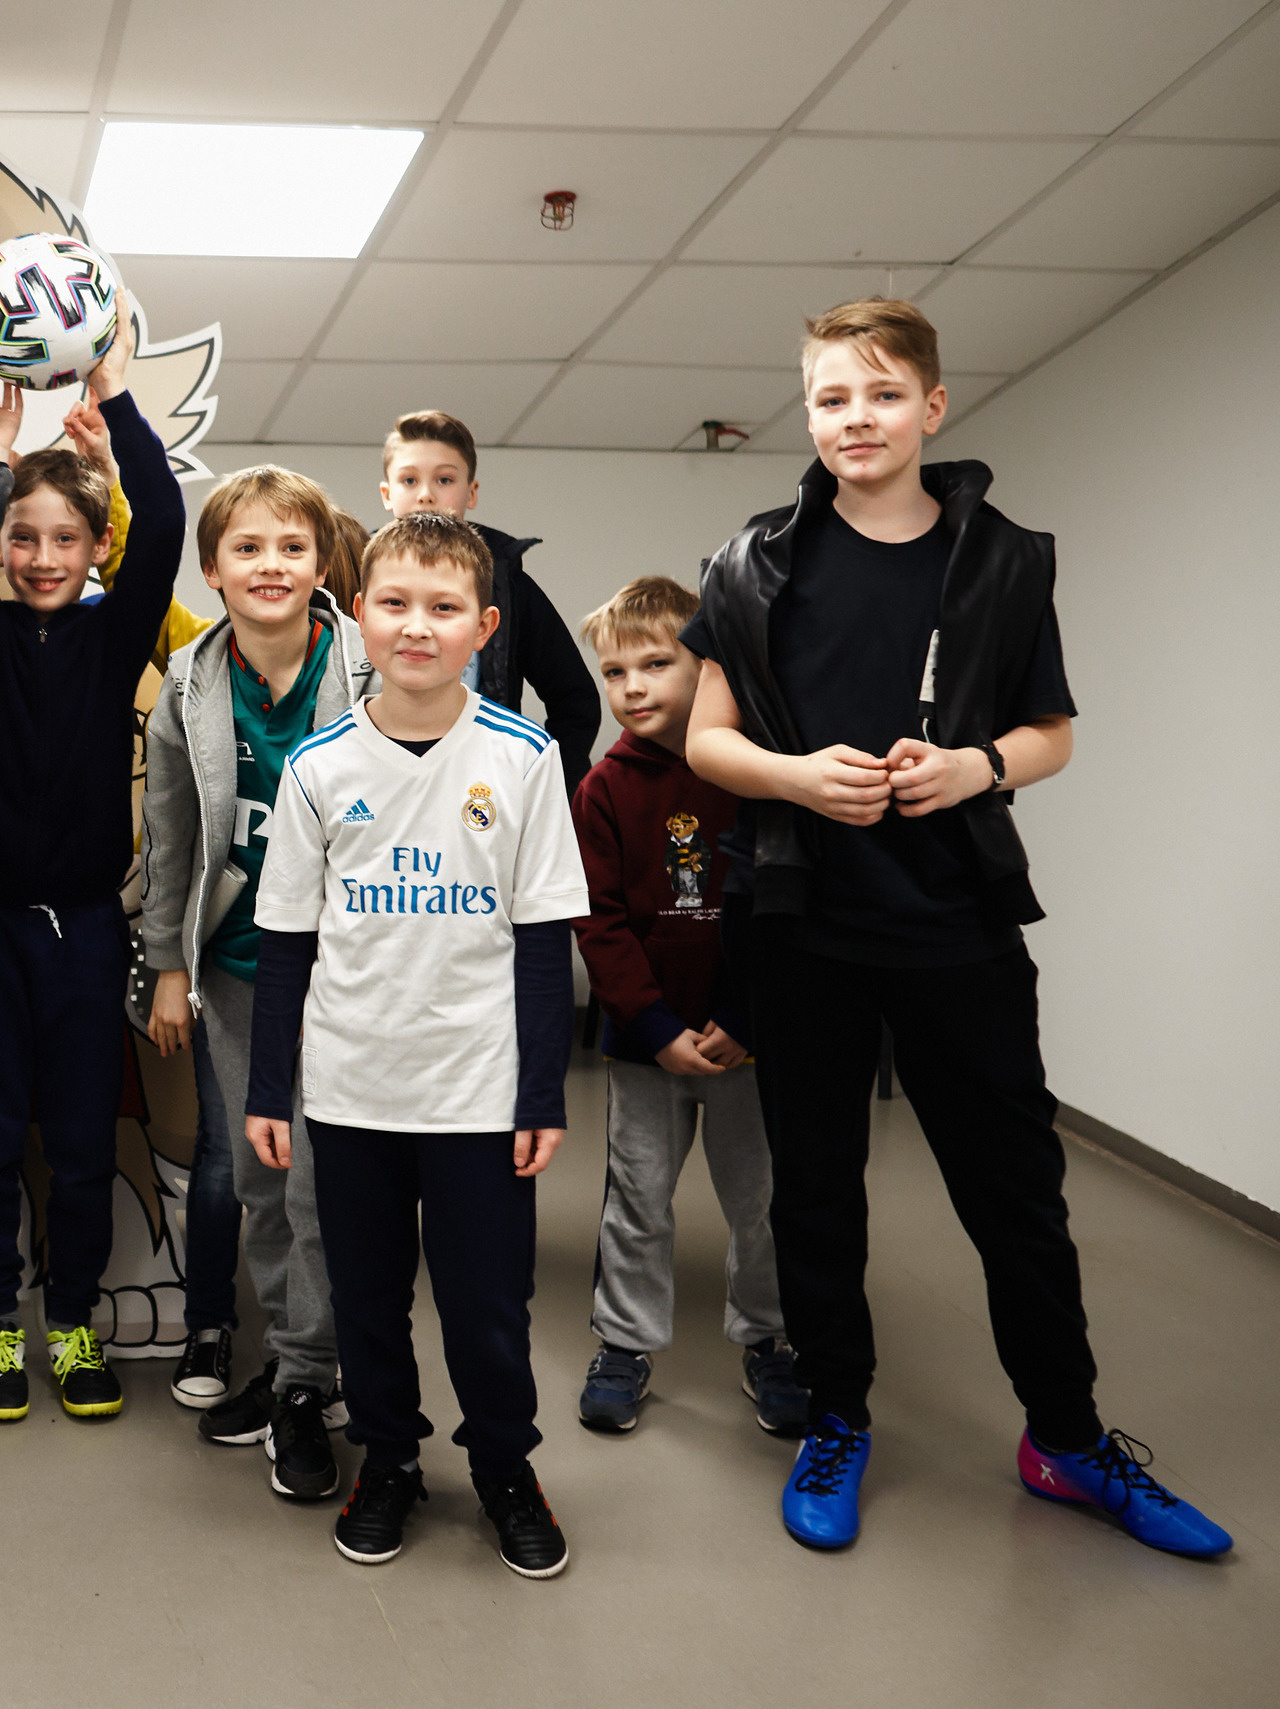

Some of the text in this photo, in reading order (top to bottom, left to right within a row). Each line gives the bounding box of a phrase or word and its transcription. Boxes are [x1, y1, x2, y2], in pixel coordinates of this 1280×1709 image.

[342, 813, 375, 823] adidas
[392, 847, 442, 877] Fly
[341, 875, 497, 914] Emirates
